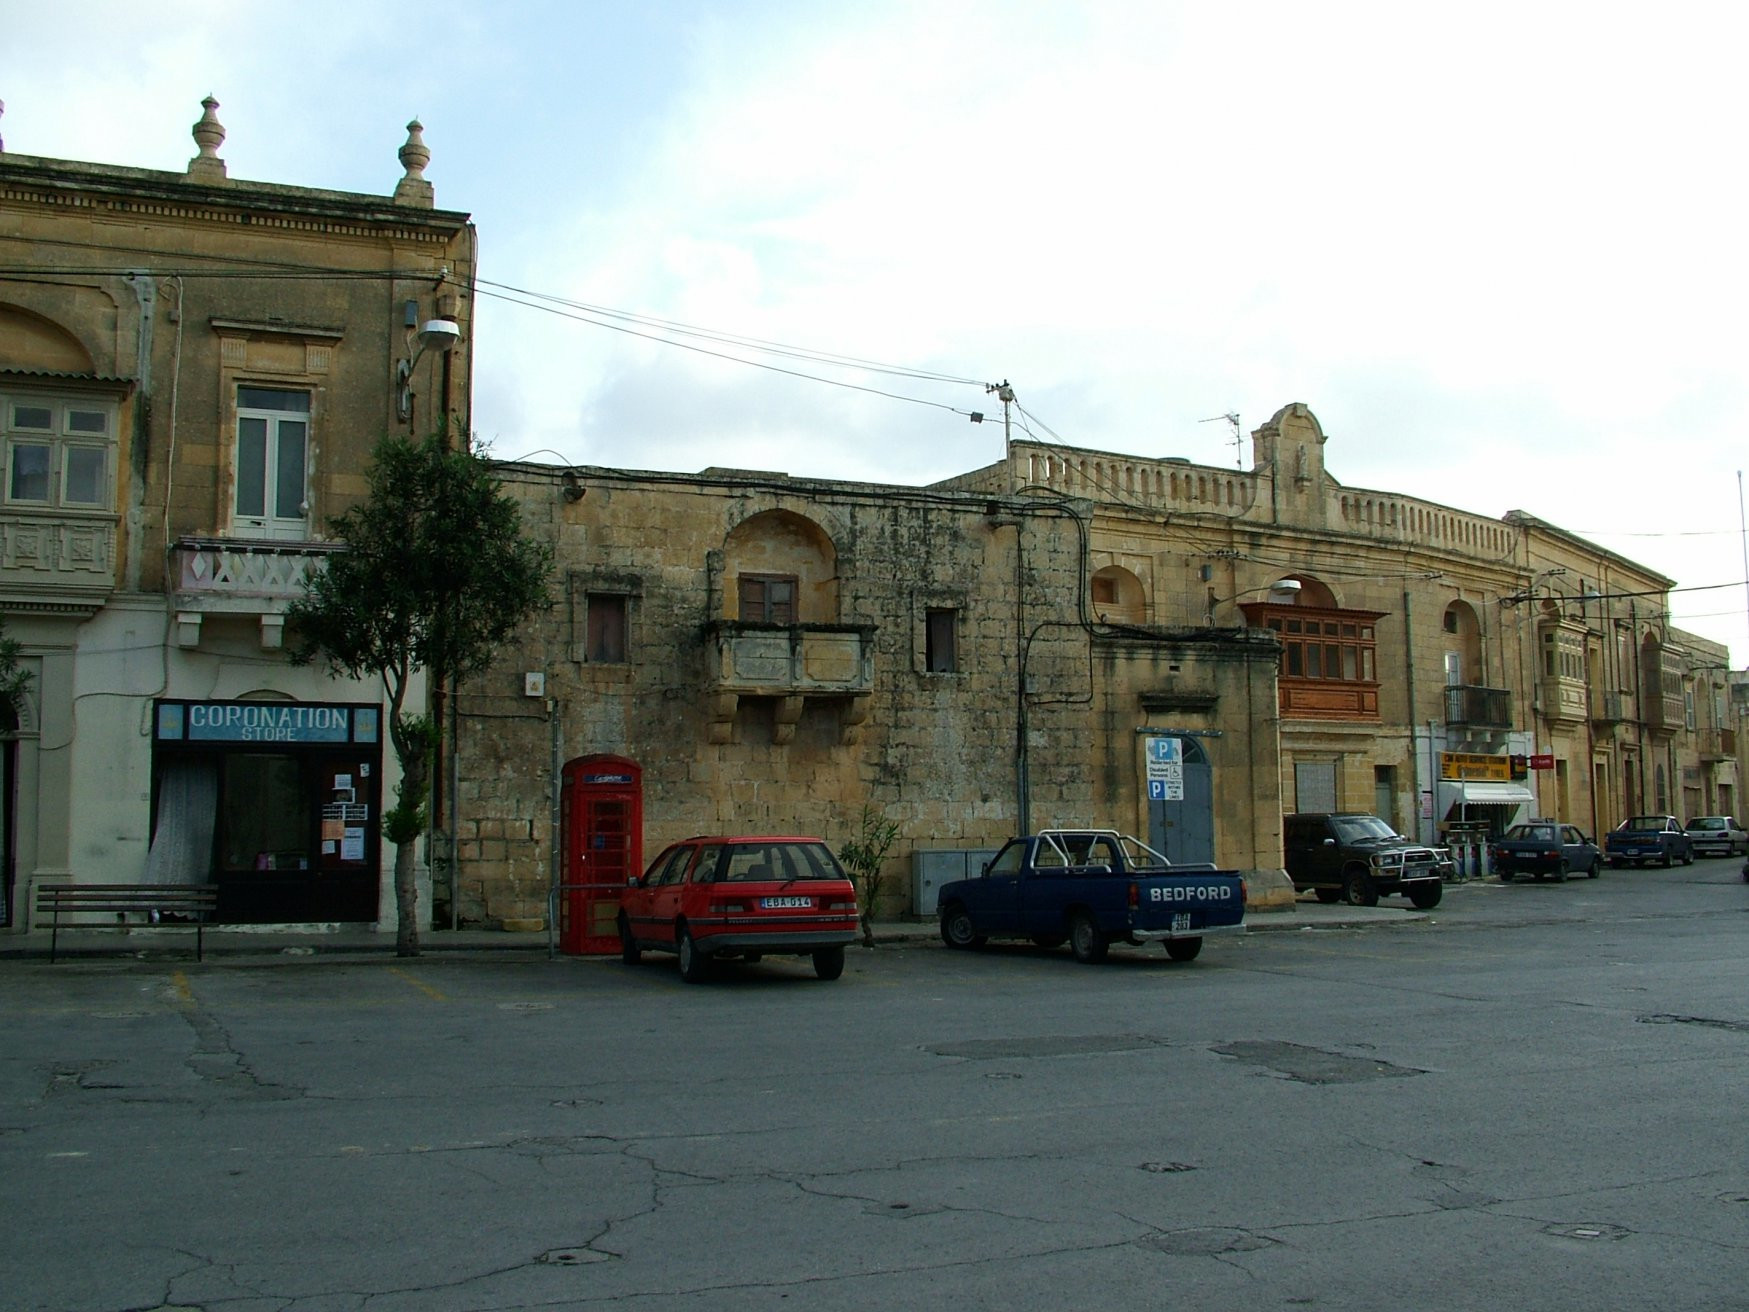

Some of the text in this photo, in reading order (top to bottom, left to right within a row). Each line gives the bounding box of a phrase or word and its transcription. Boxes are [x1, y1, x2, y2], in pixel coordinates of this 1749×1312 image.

[190, 704, 348, 729] CORONATION
[241, 727, 298, 742] STORE
[1158, 741, 1168, 758] P
[1151, 781, 1161, 798] P
[767, 897, 811, 907] EBA 014
[1150, 886, 1231, 902] BEDFORD
